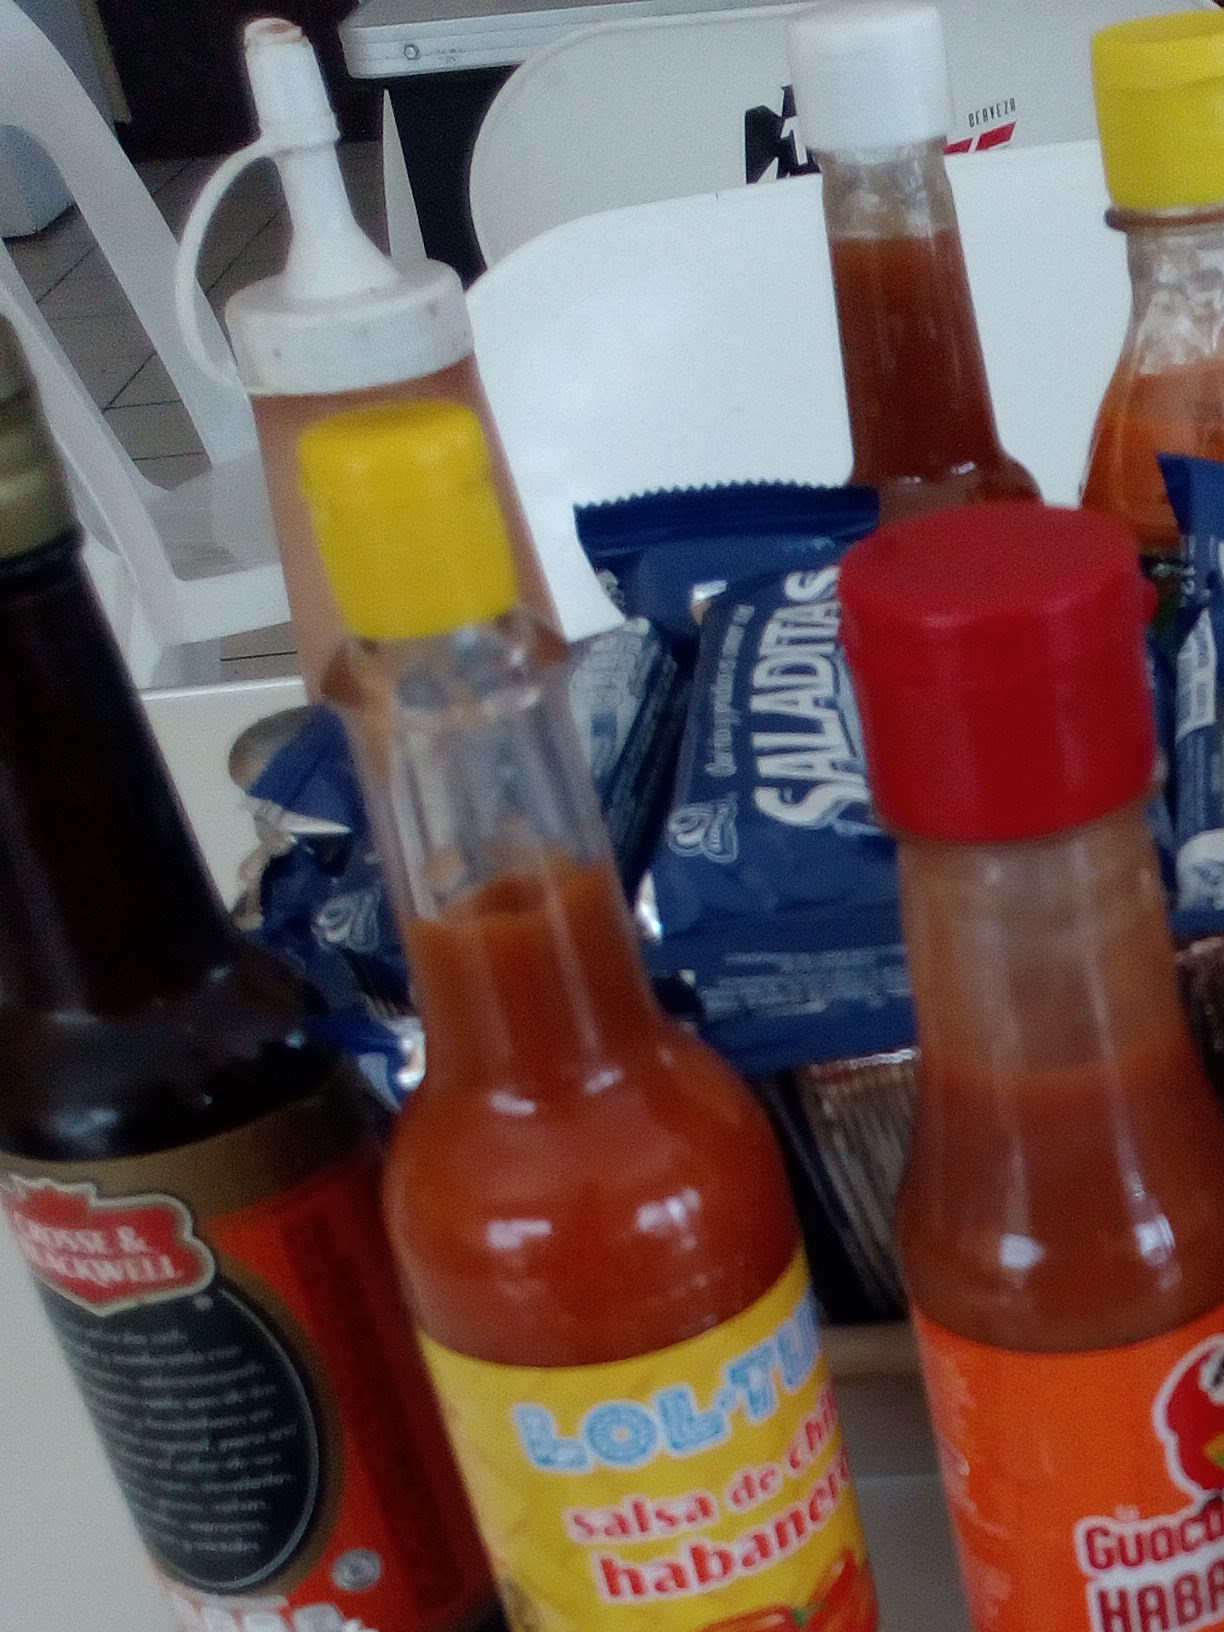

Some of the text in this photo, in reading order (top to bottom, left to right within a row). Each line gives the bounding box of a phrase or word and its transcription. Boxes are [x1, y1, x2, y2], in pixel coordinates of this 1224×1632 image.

[968, 97, 1016, 128] CERVEZA
[752, 566, 873, 828] SALADITAS
[117, 1226, 150, 1253] &
[19, 1238, 180, 1288] ACKWELL
[730, 1466, 782, 1508] de
